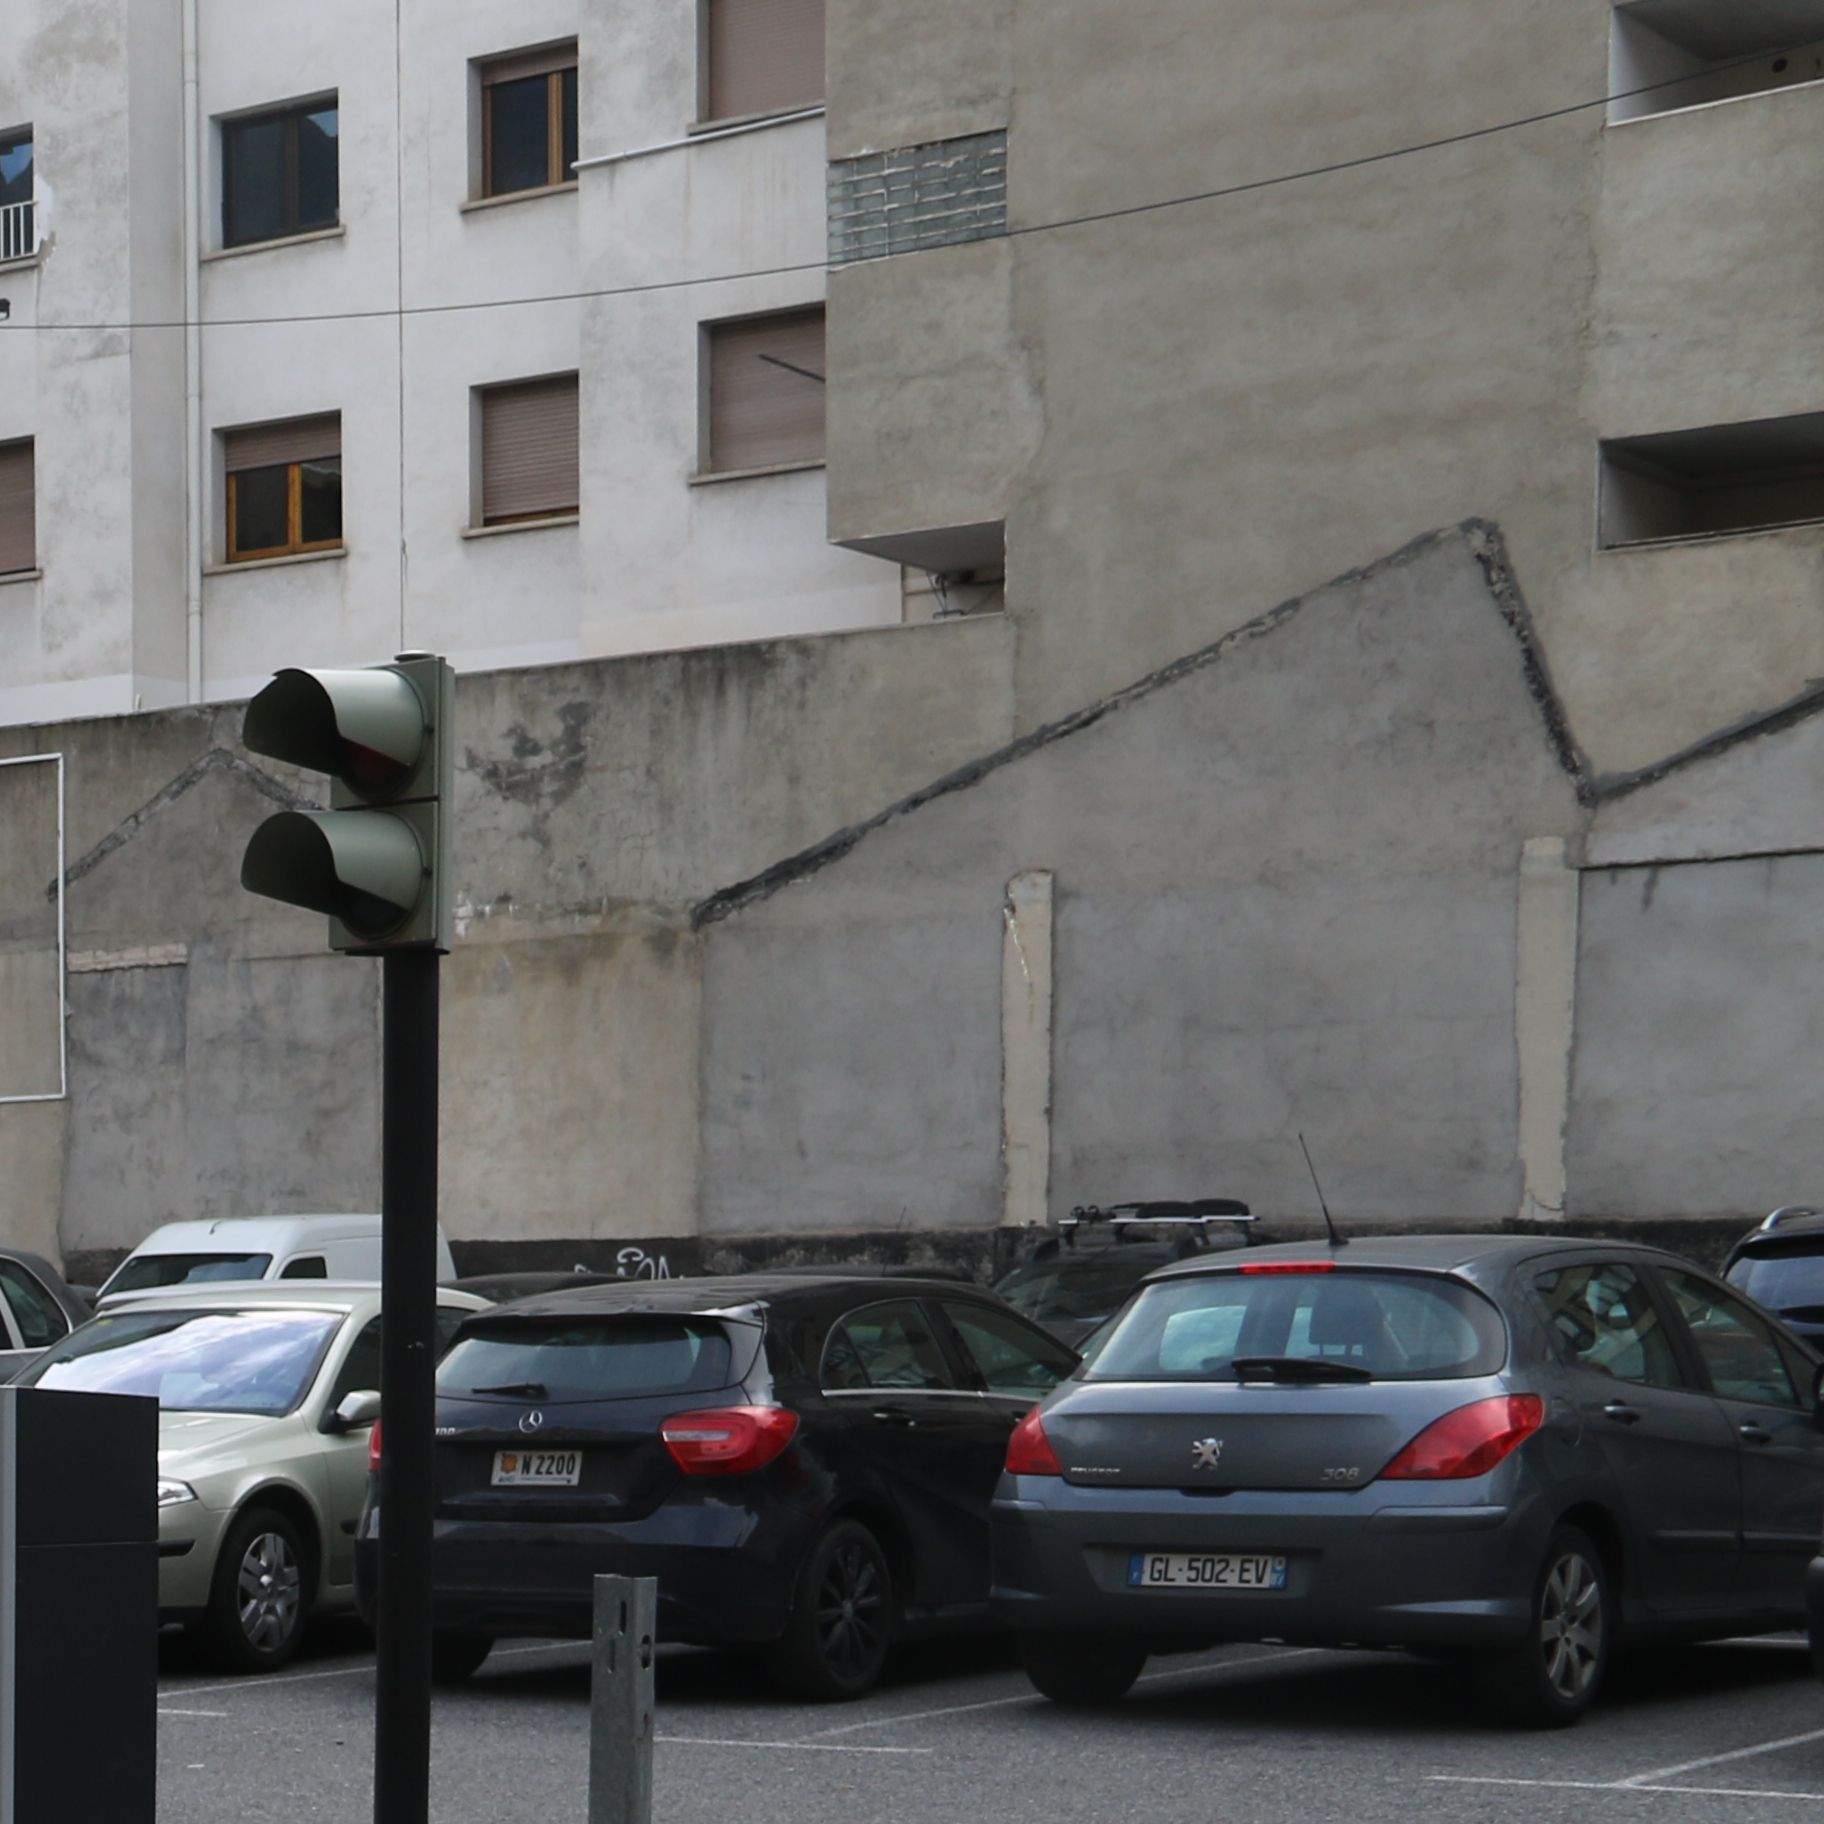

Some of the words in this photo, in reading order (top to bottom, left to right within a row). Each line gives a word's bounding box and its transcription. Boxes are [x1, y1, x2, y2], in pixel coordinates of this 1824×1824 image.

[520, 1454, 532, 1475] N
[535, 1453, 575, 1475] 2200
[1320, 1466, 1360, 1480] 308
